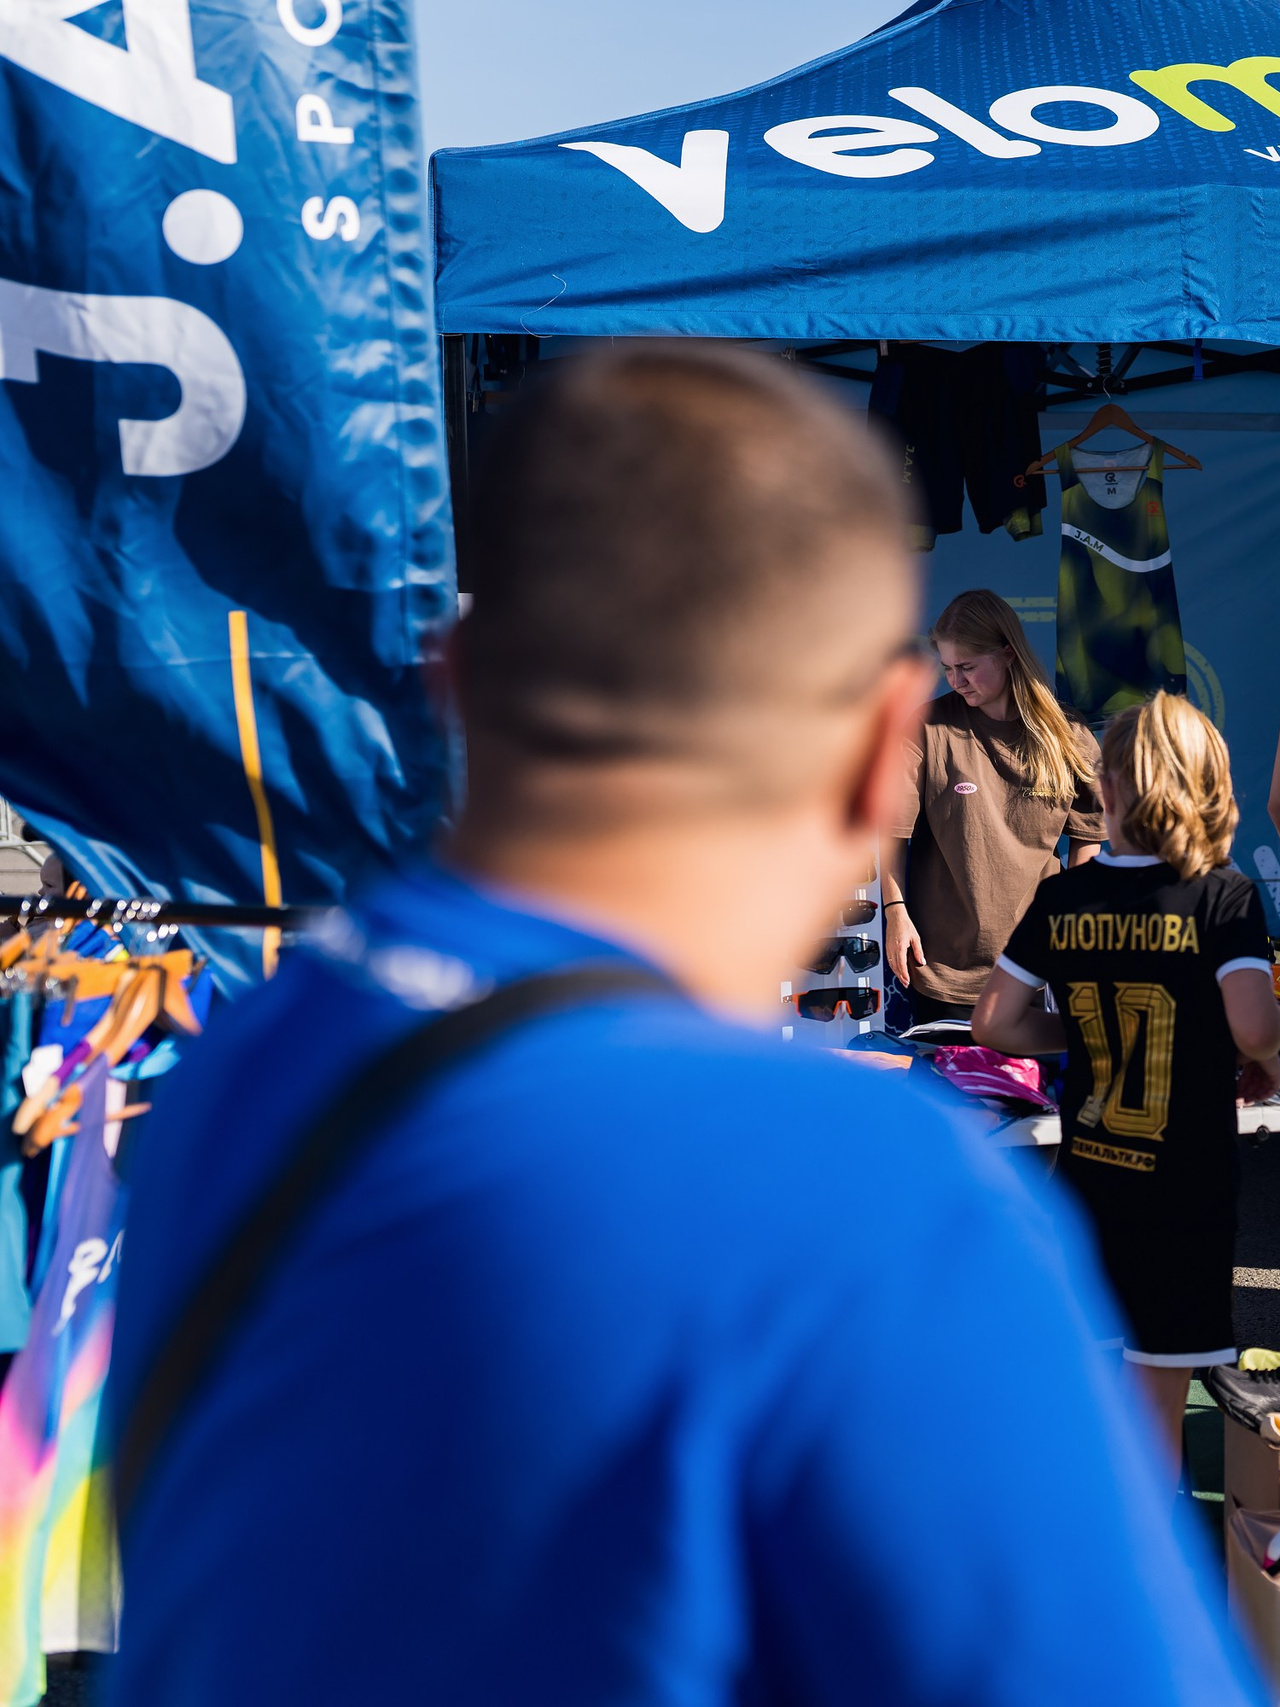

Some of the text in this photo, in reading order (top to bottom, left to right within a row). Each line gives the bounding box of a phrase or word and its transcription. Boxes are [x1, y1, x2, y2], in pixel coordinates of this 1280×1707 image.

[1107, 487, 1117, 495] M
[1074, 530, 1105, 552] J.A.M
[1048, 914, 1200, 954] ХЛОПУНОВА
[1066, 982, 1176, 1142] 10
